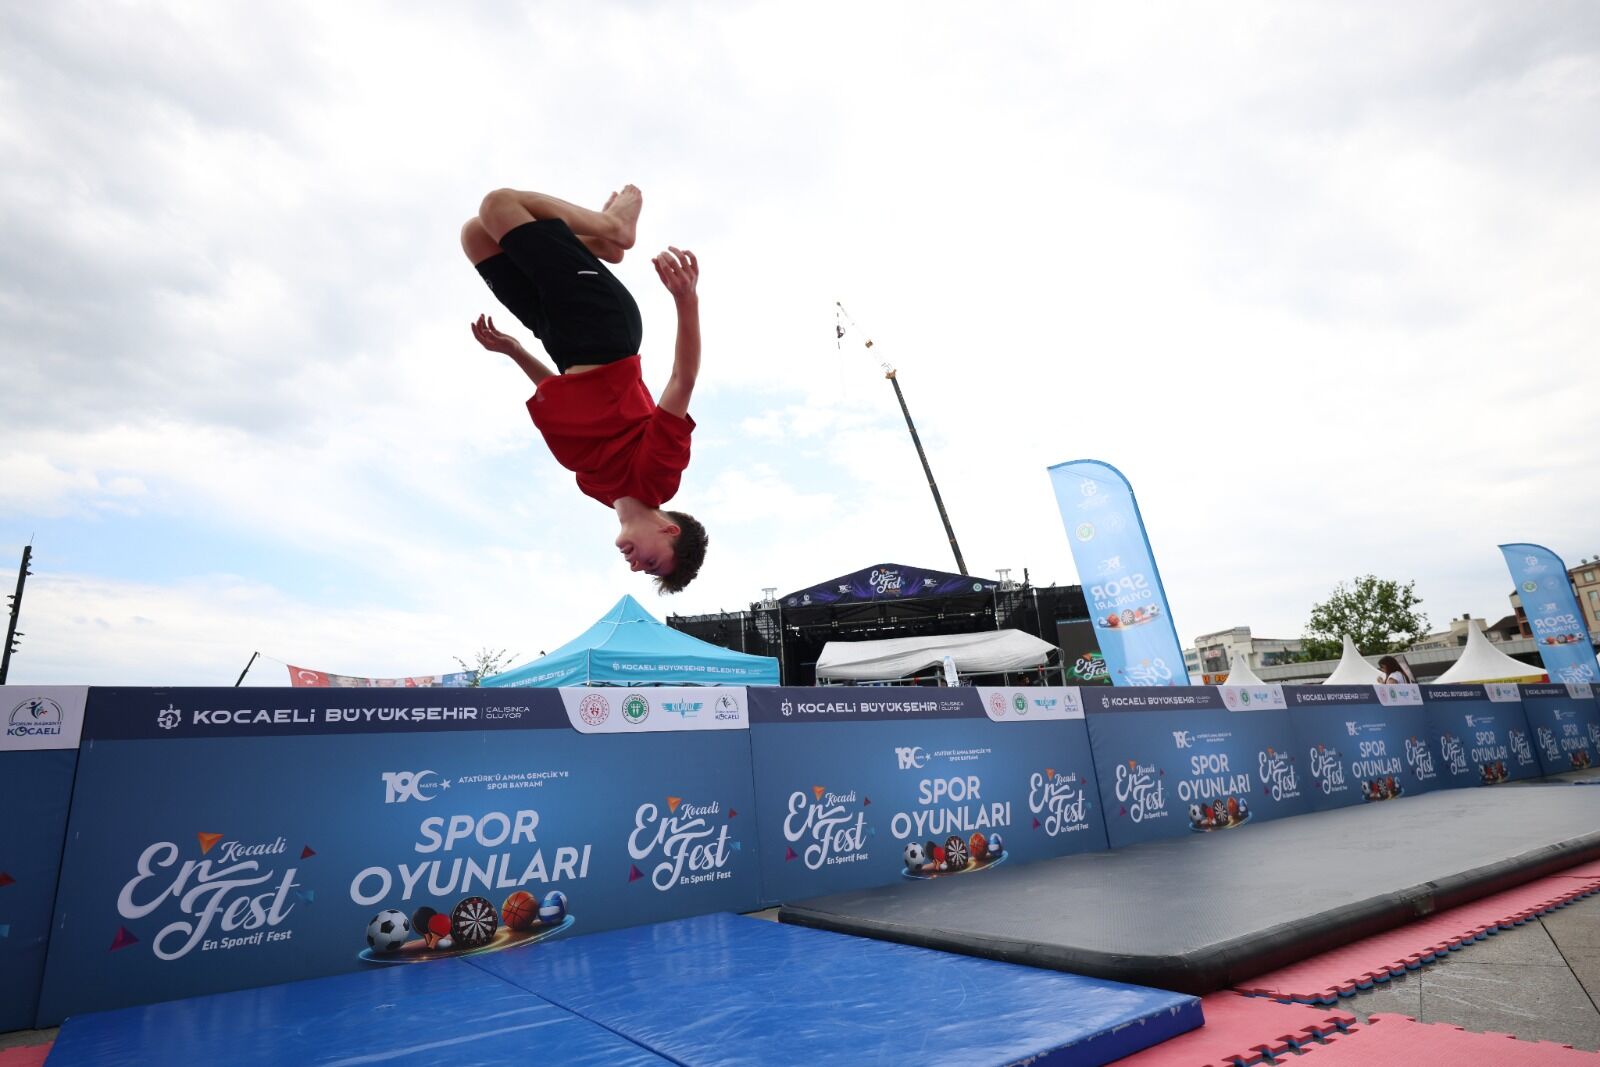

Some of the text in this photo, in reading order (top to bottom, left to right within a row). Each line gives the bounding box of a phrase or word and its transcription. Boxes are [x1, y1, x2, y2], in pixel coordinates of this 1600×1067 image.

[877, 576, 901, 593] Fest
[193, 706, 478, 724] KOCAELİ BÜYÜKŞEHİR
[797, 701, 937, 713] KOCAELİ BÜYÜKŞEHİR
[7, 725, 61, 737] KOCAELİ
[1475, 731, 1496, 745] SPOR
[1310, 748, 1334, 777] En
[1360, 740, 1386, 758] SPOR
[1471, 746, 1508, 763] OYUNLARI
[503, 772, 525, 781] ANMA
[1191, 753, 1230, 776] SPOR
[1258, 751, 1288, 784] En
[1322, 760, 1345, 795] Fest
[1352, 757, 1402, 778] OYUNLARI
[487, 781, 543, 790] SPOR BAYRAMI
[918, 776, 980, 805] SPOR
[1029, 772, 1071, 814] En
[1115, 764, 1150, 802] En
[1178, 774, 1250, 801] OYUNLARI
[1271, 765, 1298, 801] Fest
[680, 800, 720, 820] Kocaeli
[825, 790, 856, 807] Kocaeli
[1130, 780, 1166, 823] Fest
[784, 792, 845, 842] En
[891, 801, 1011, 840] OYUNLARI
[1044, 789, 1086, 837] Fest
[414, 809, 539, 853] SPOR
[627, 803, 704, 860] En
[804, 809, 867, 870] Fest
[218, 837, 287, 864] Kocaeli
[651, 824, 731, 891] Fest
[835, 854, 855, 865] Sportif
[117, 841, 259, 920] En
[350, 844, 592, 906] OYUNLARI
[680, 871, 731, 884] En Sportif Fest
[152, 868, 301, 961] Fest
[202, 930, 292, 951] En Sportif Fest
